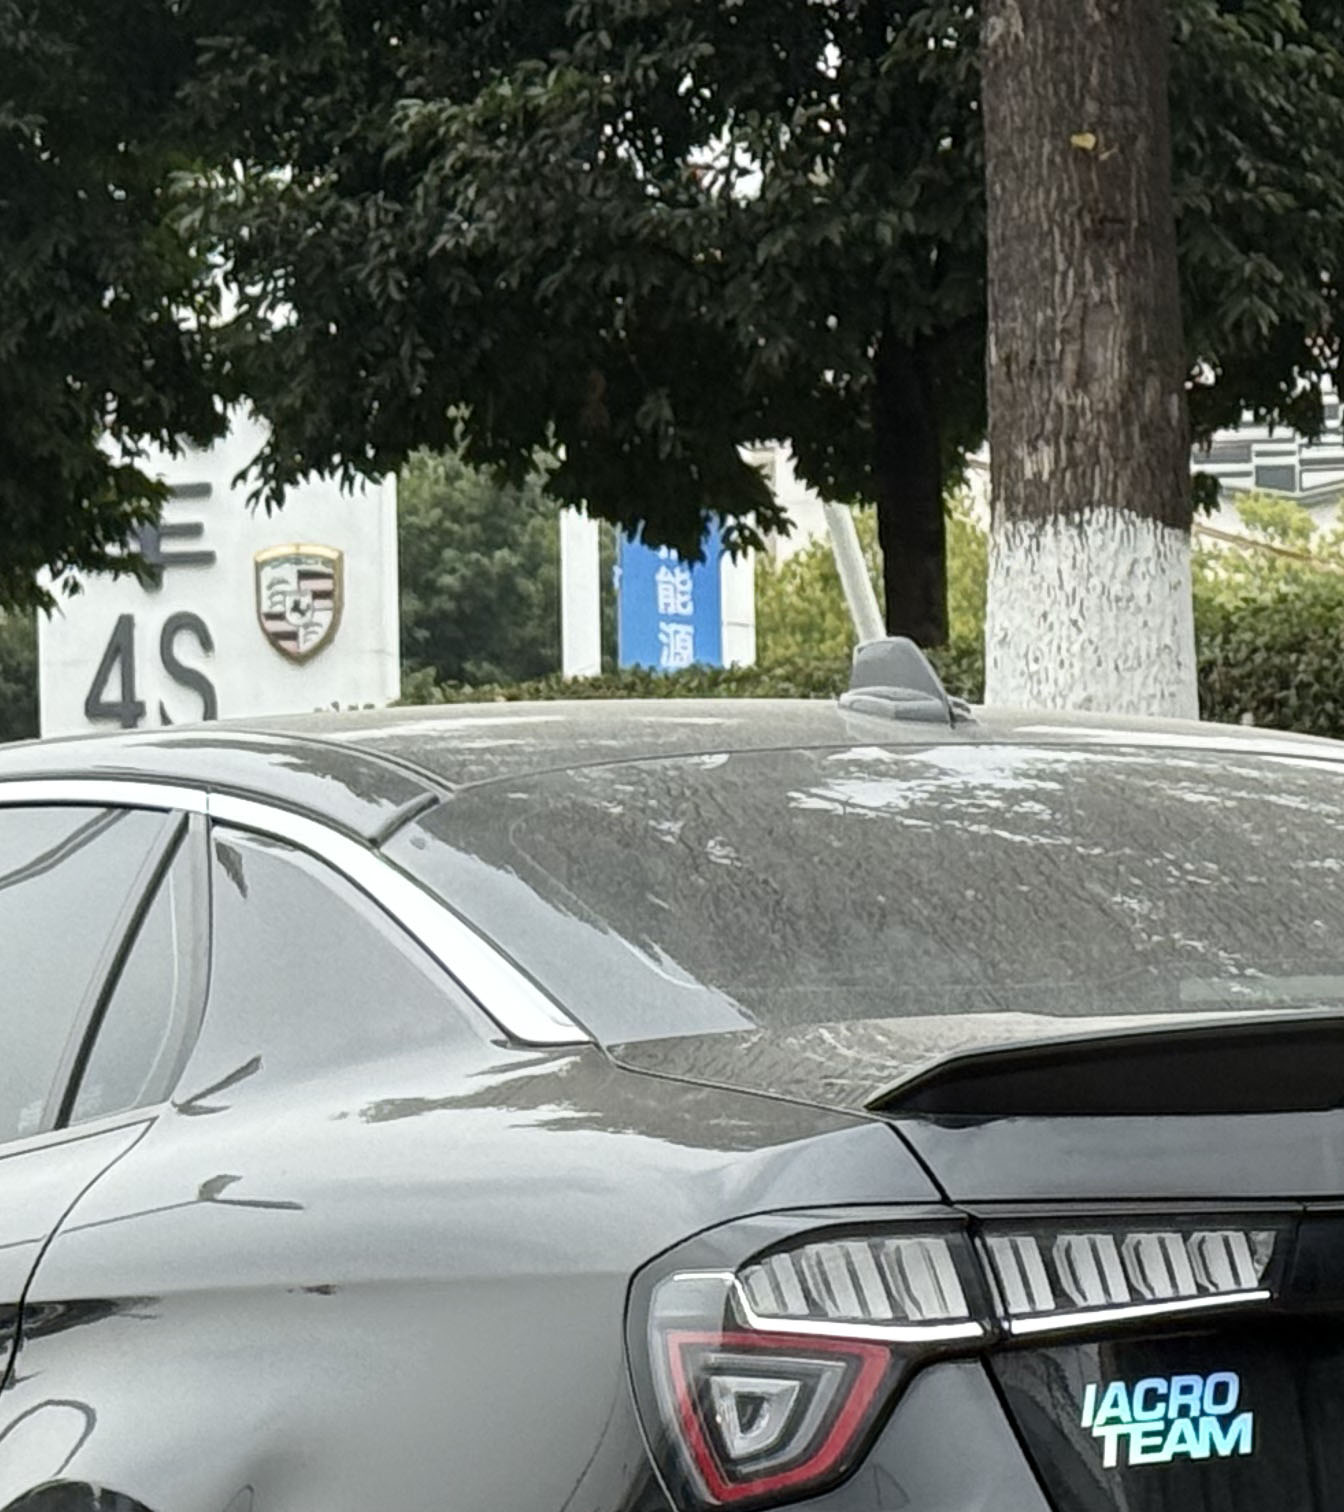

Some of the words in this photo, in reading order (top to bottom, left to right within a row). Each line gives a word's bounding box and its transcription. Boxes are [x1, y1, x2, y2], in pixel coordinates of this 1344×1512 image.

[656, 545, 695, 667] 能源
[85, 611, 217, 728] 4S
[1092, 1412, 1253, 1468] TEAM
